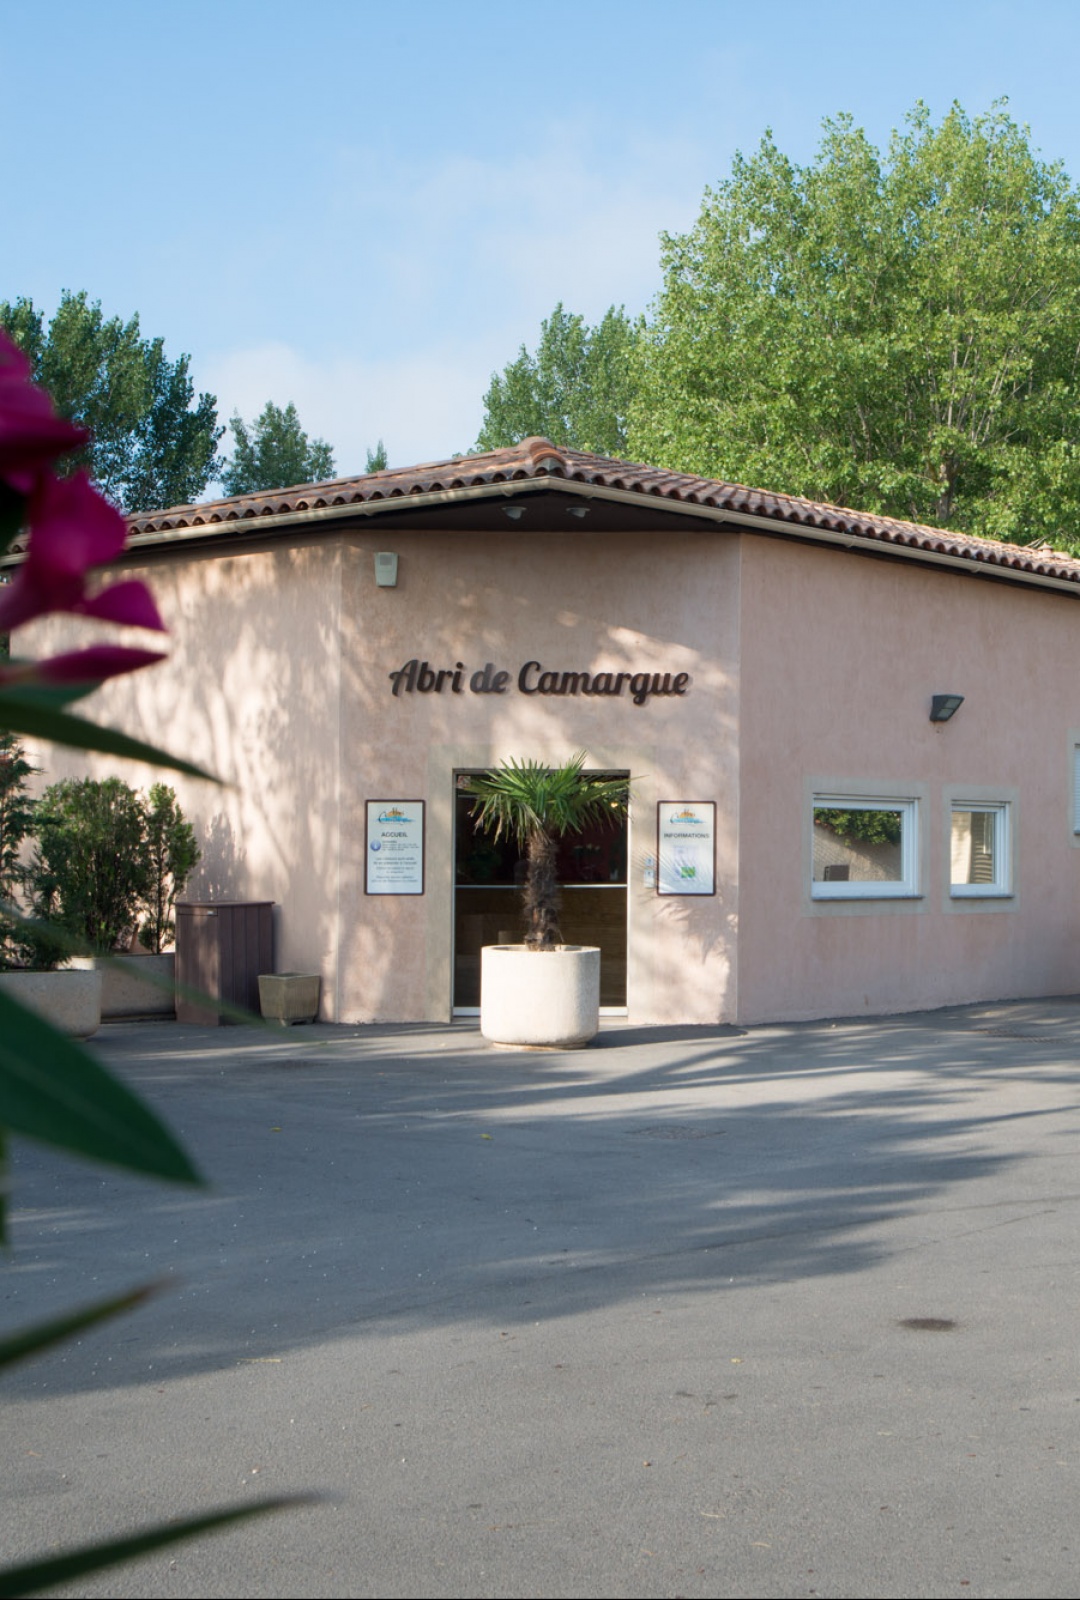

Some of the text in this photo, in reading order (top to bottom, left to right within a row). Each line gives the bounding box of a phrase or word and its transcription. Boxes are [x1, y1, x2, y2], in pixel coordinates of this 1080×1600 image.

[389, 659, 690, 705] Abri de Camargue
